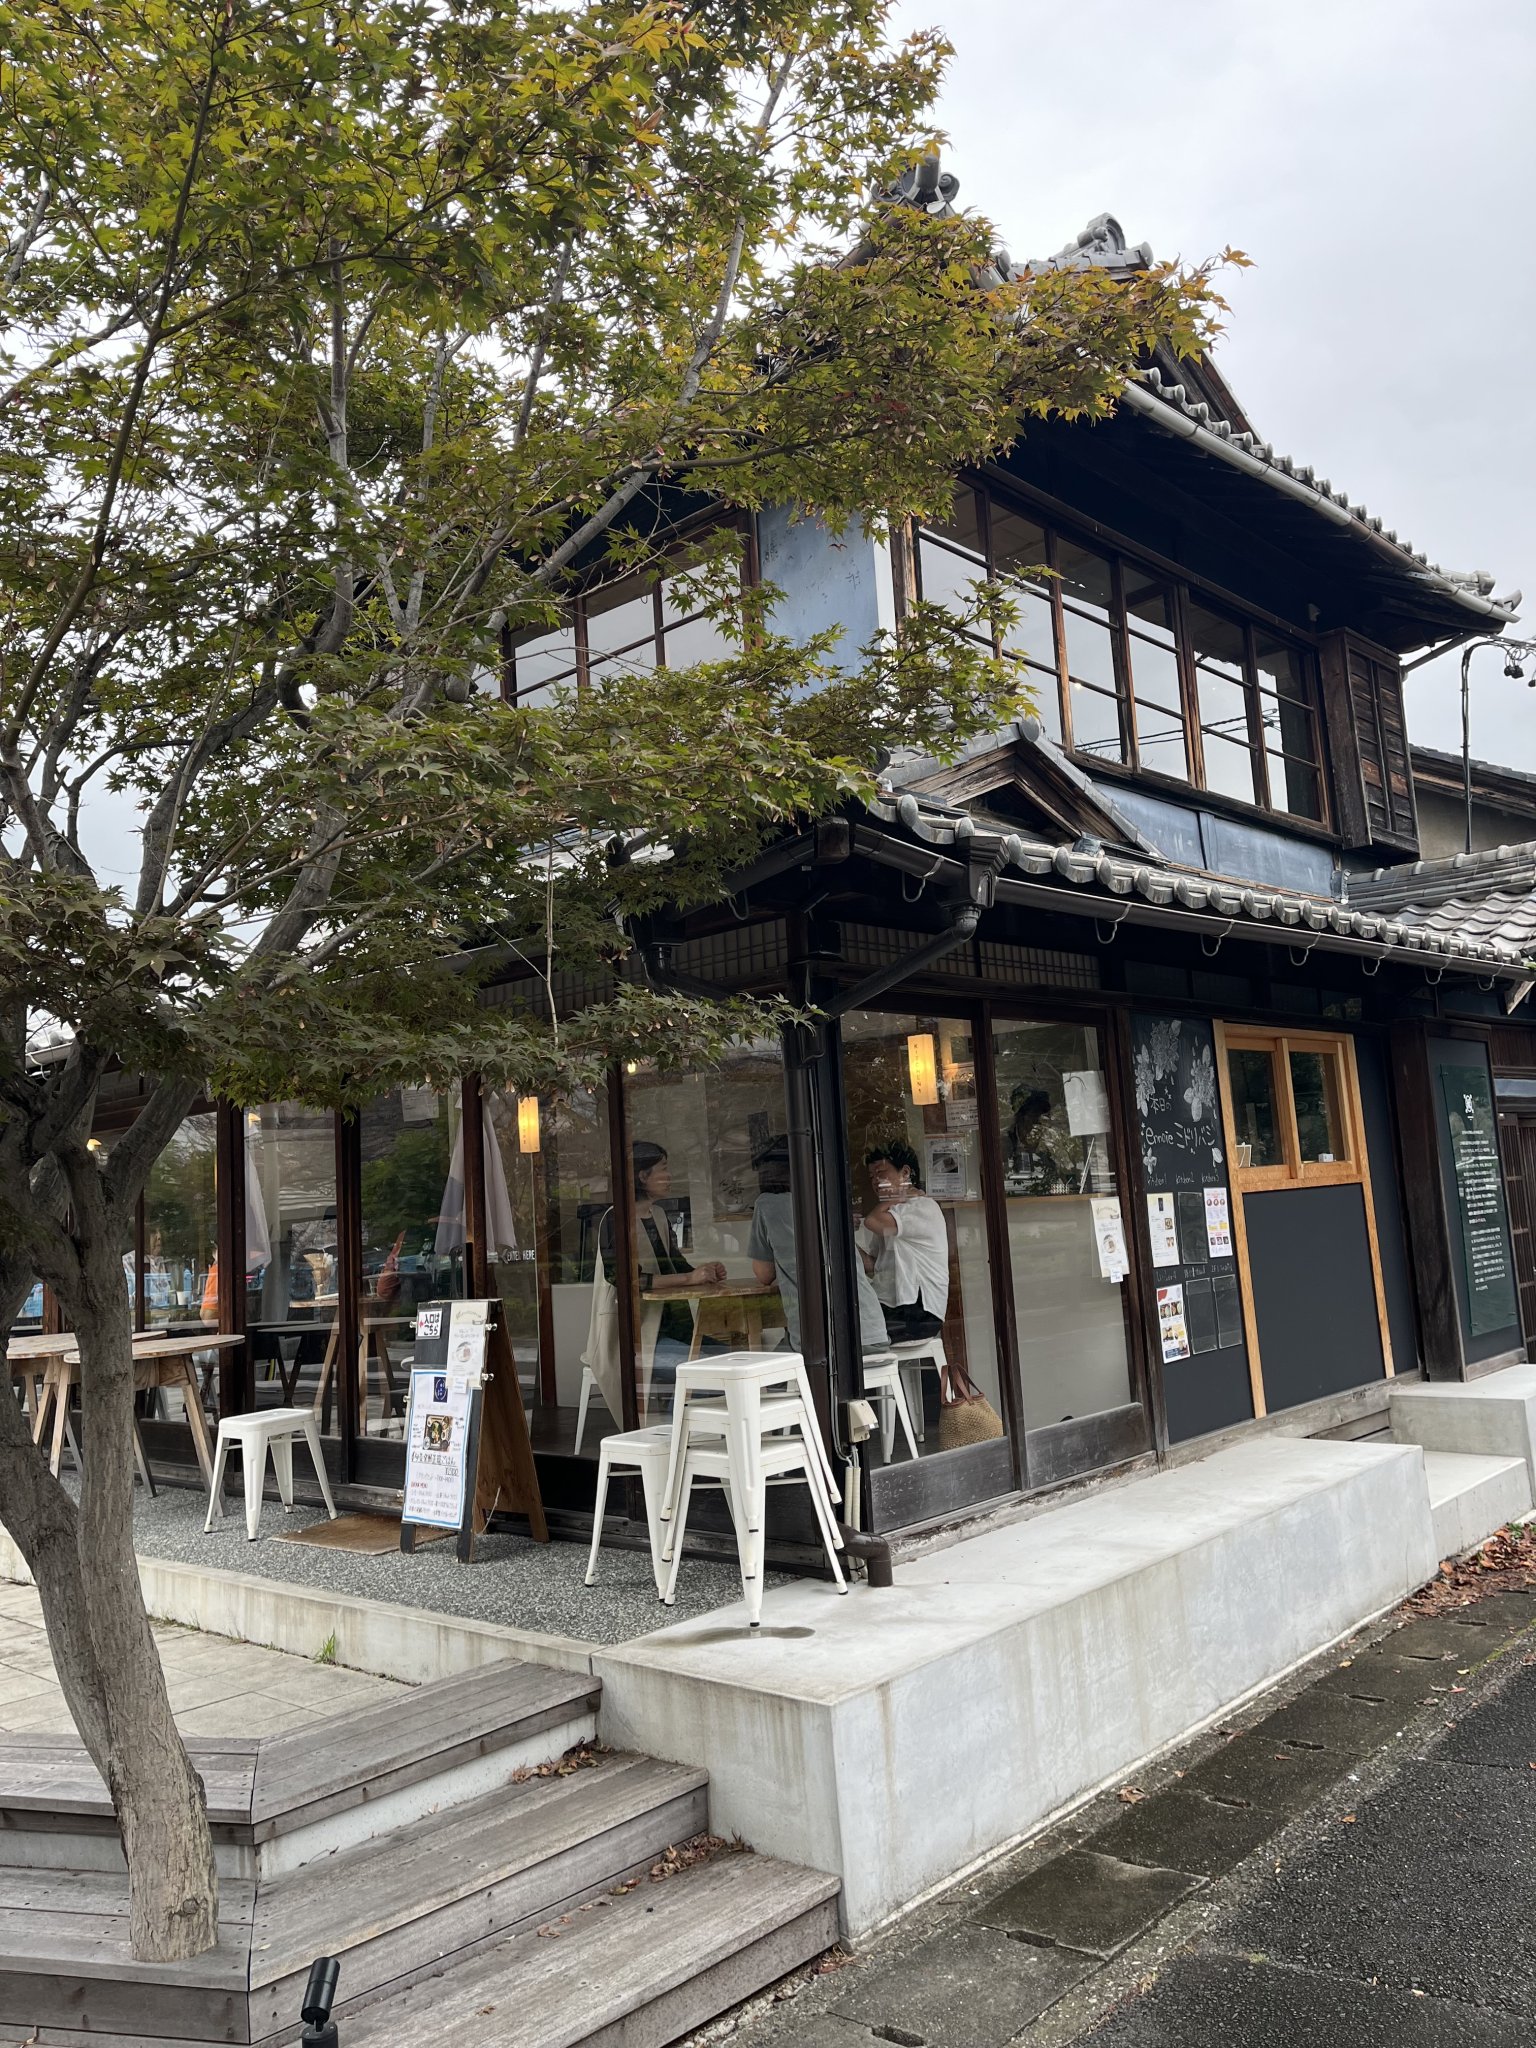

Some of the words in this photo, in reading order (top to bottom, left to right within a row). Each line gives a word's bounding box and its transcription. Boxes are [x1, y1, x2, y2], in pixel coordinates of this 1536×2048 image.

[1150, 1094, 1172, 1114] 本日の
[1174, 1122, 1215, 1149] ミドリバシ
[424, 1312, 440, 1324] 入口は
[424, 1324, 439, 1336] こちら
